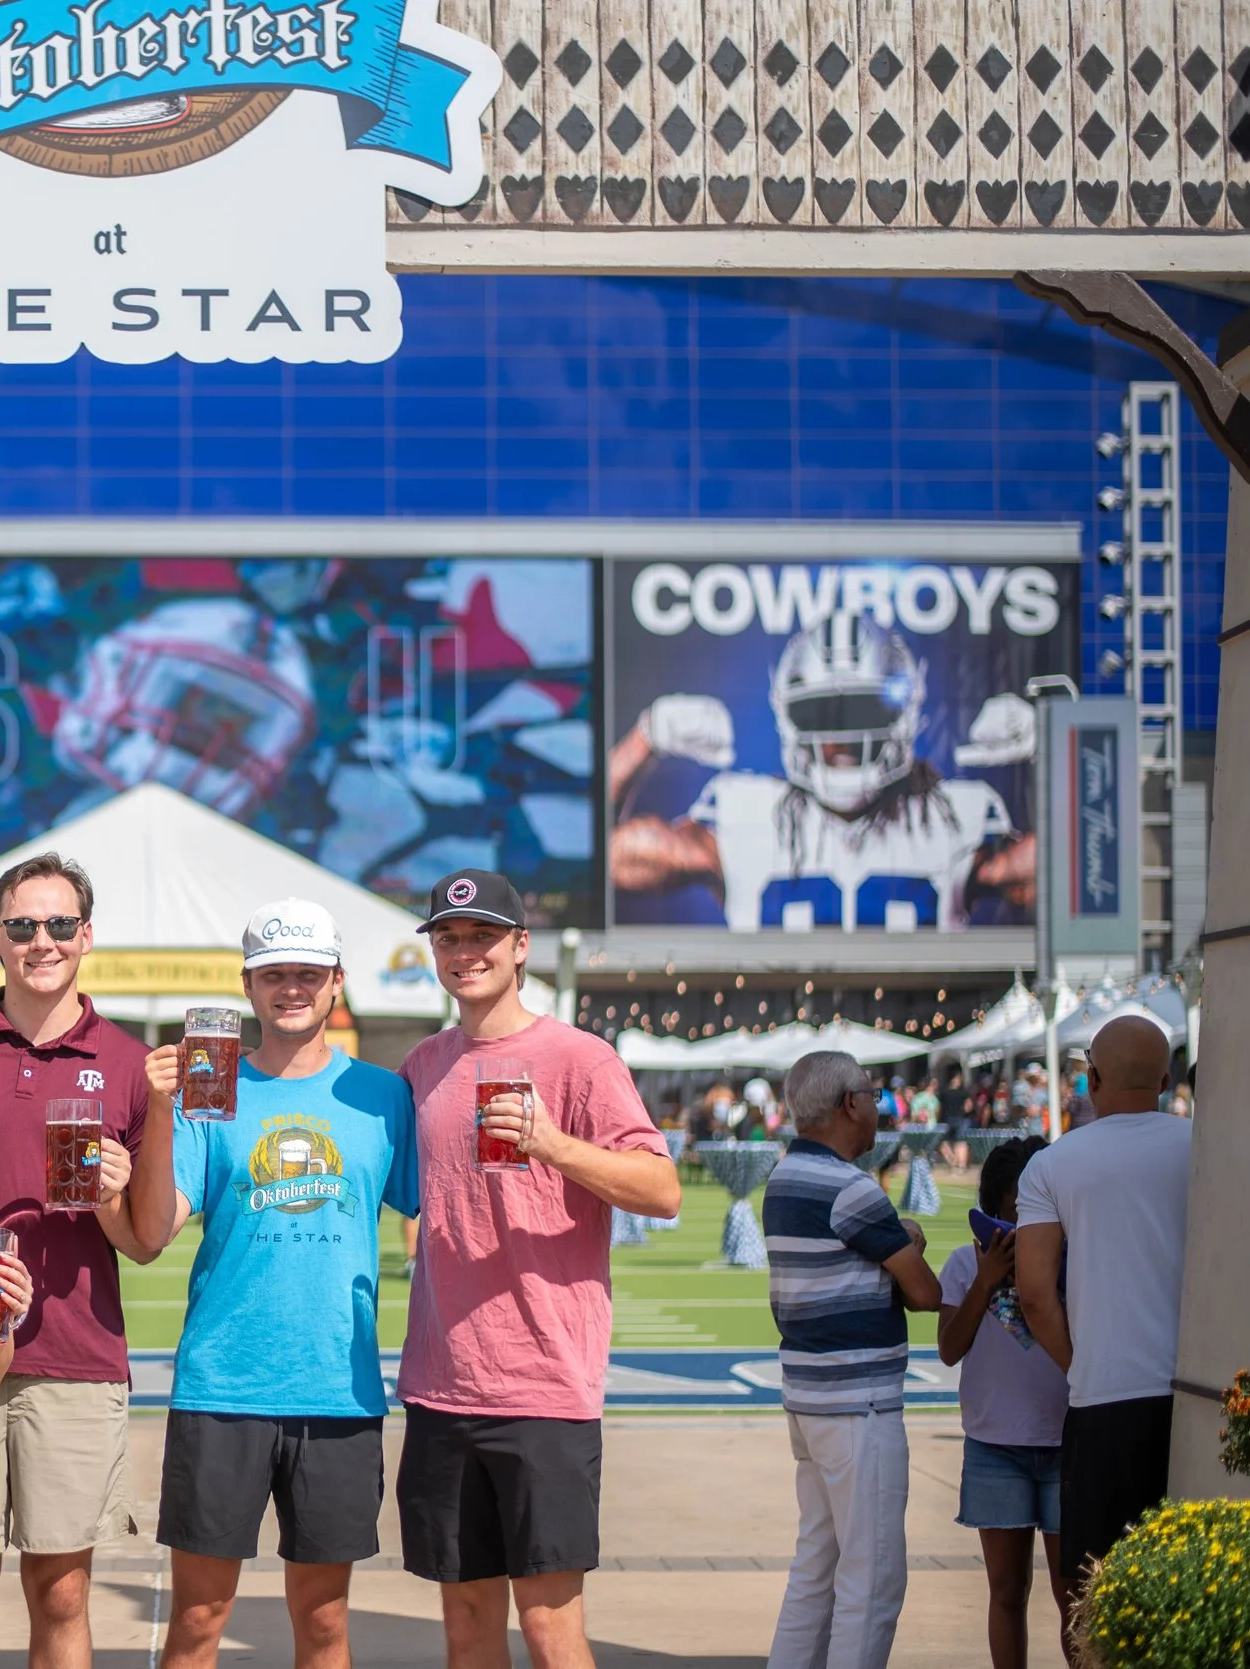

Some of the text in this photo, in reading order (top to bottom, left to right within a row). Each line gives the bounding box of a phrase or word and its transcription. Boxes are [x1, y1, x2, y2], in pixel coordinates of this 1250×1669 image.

[93, 223, 127, 256] at
[111, 287, 372, 333] STAR
[261, 918, 315, 942] Good
[261, 1113, 331, 1131] FRISCO
[250, 1178, 342, 1211] Oktoberfest
[247, 1233, 342, 1243] THE STAR
